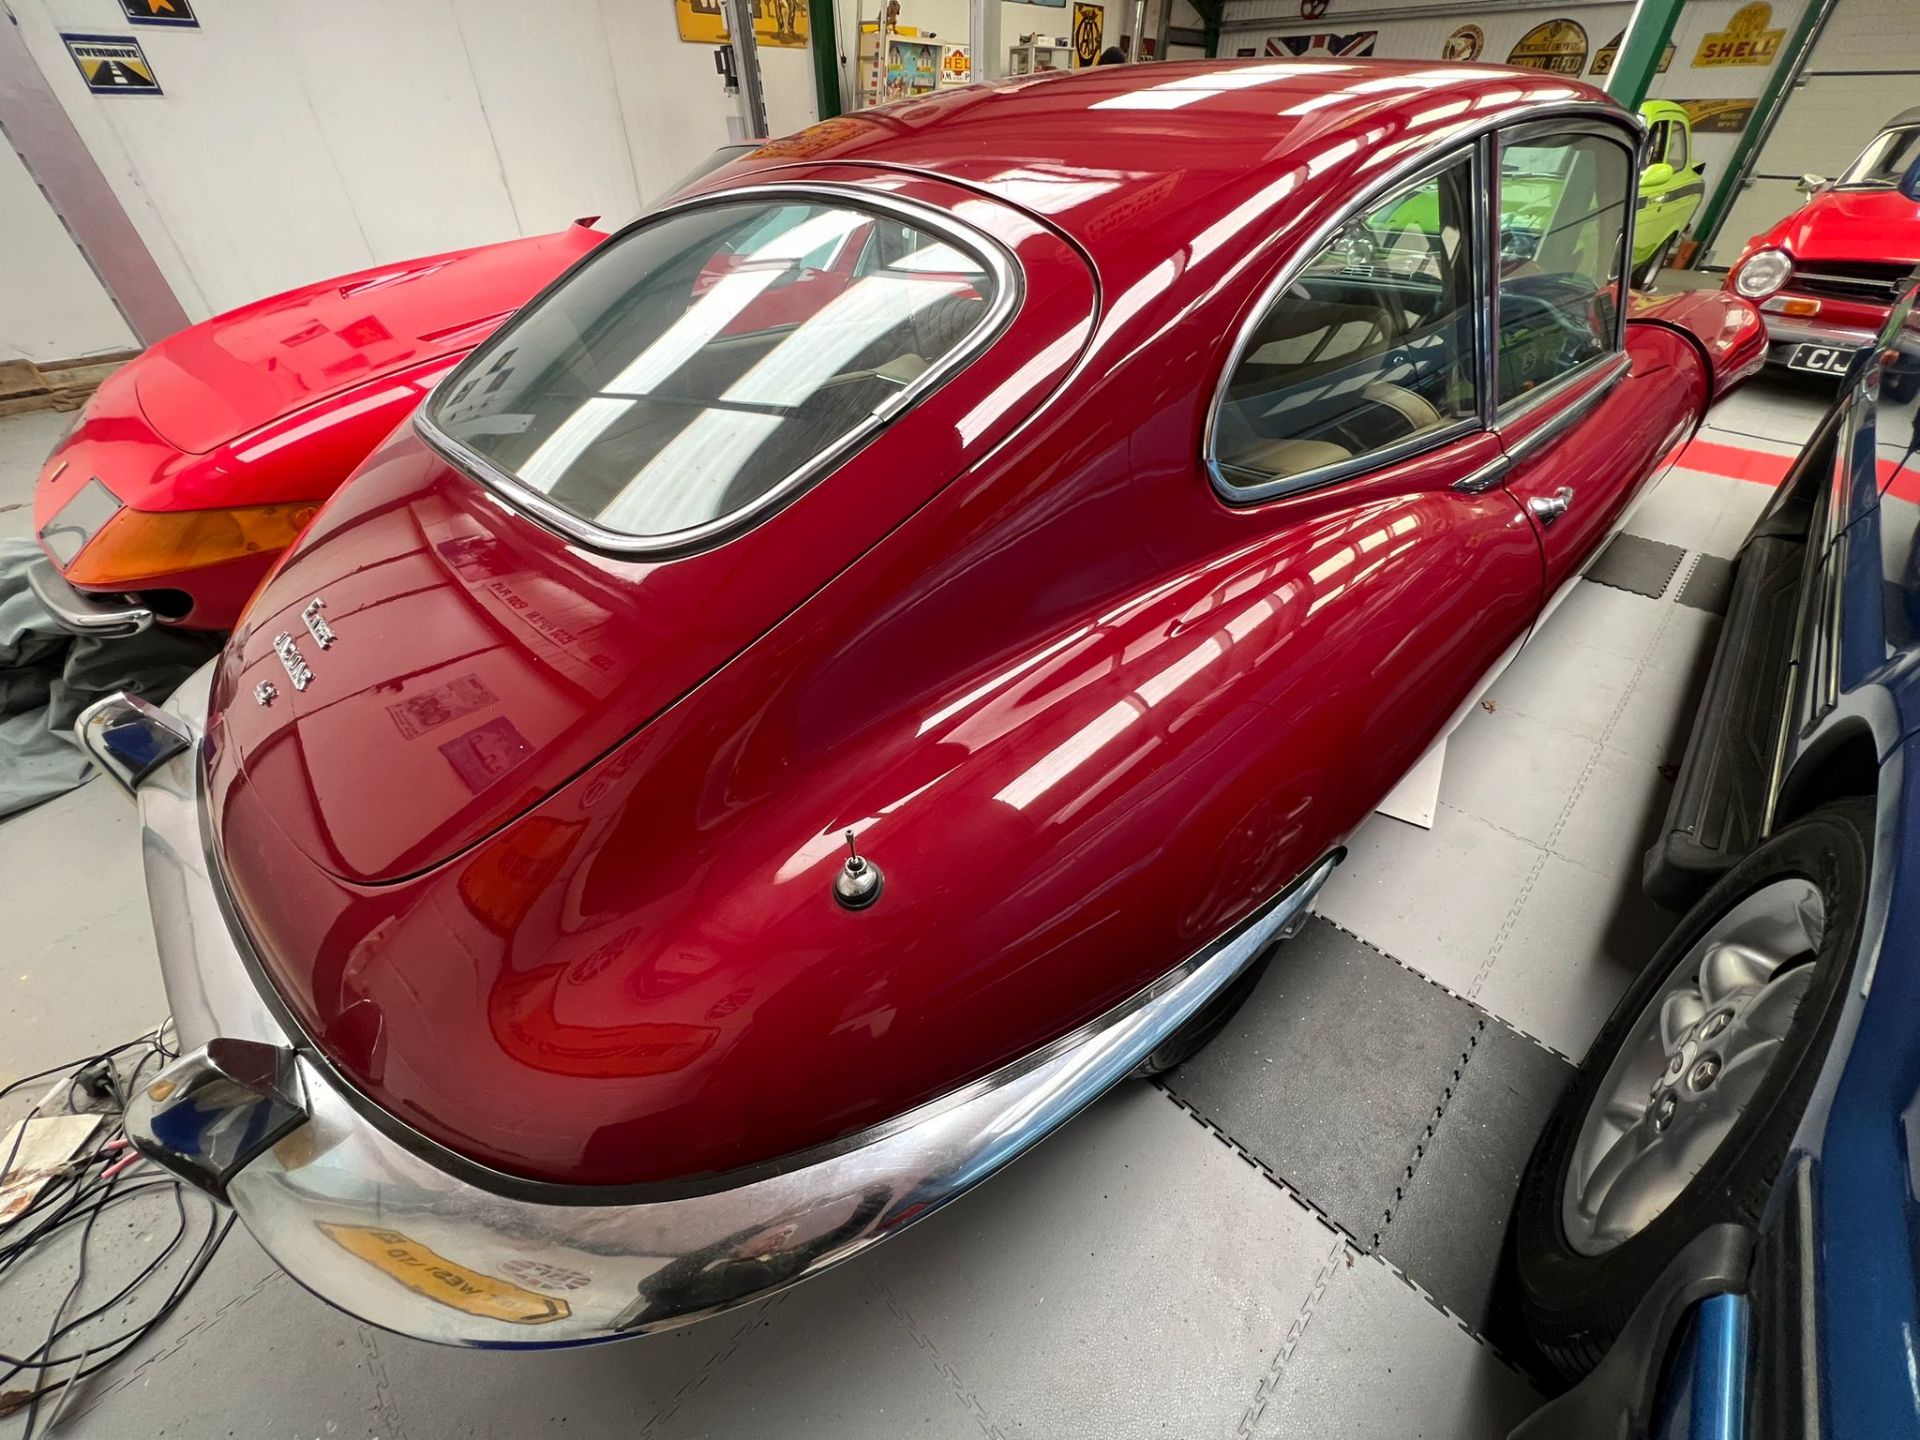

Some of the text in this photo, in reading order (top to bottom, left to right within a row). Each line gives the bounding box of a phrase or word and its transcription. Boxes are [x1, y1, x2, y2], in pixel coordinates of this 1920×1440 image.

[74, 47, 139, 58] OVERDRIVE
[1703, 40, 1773, 58] SHELL
[273, 631, 314, 690] JAGUAR
